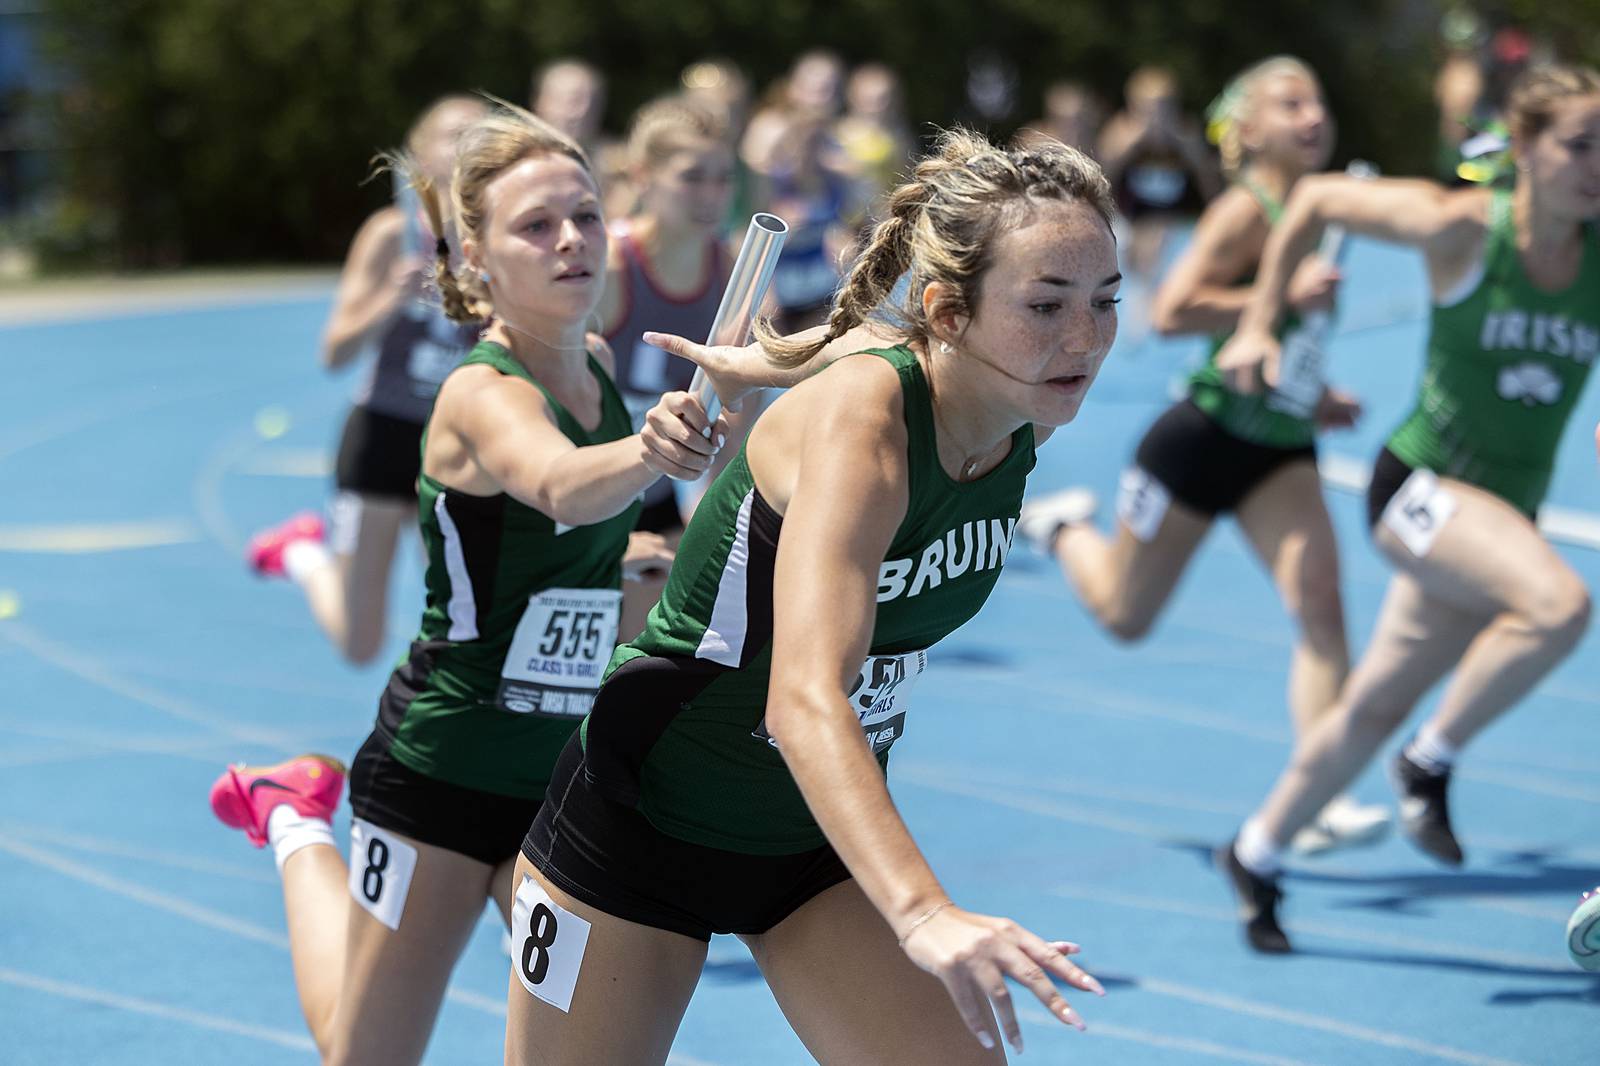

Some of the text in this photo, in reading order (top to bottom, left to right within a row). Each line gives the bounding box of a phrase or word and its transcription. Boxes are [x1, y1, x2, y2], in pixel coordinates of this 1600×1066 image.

[538, 609, 605, 660] 555
[363, 838, 388, 903] 8
[521, 902, 558, 985] 8
